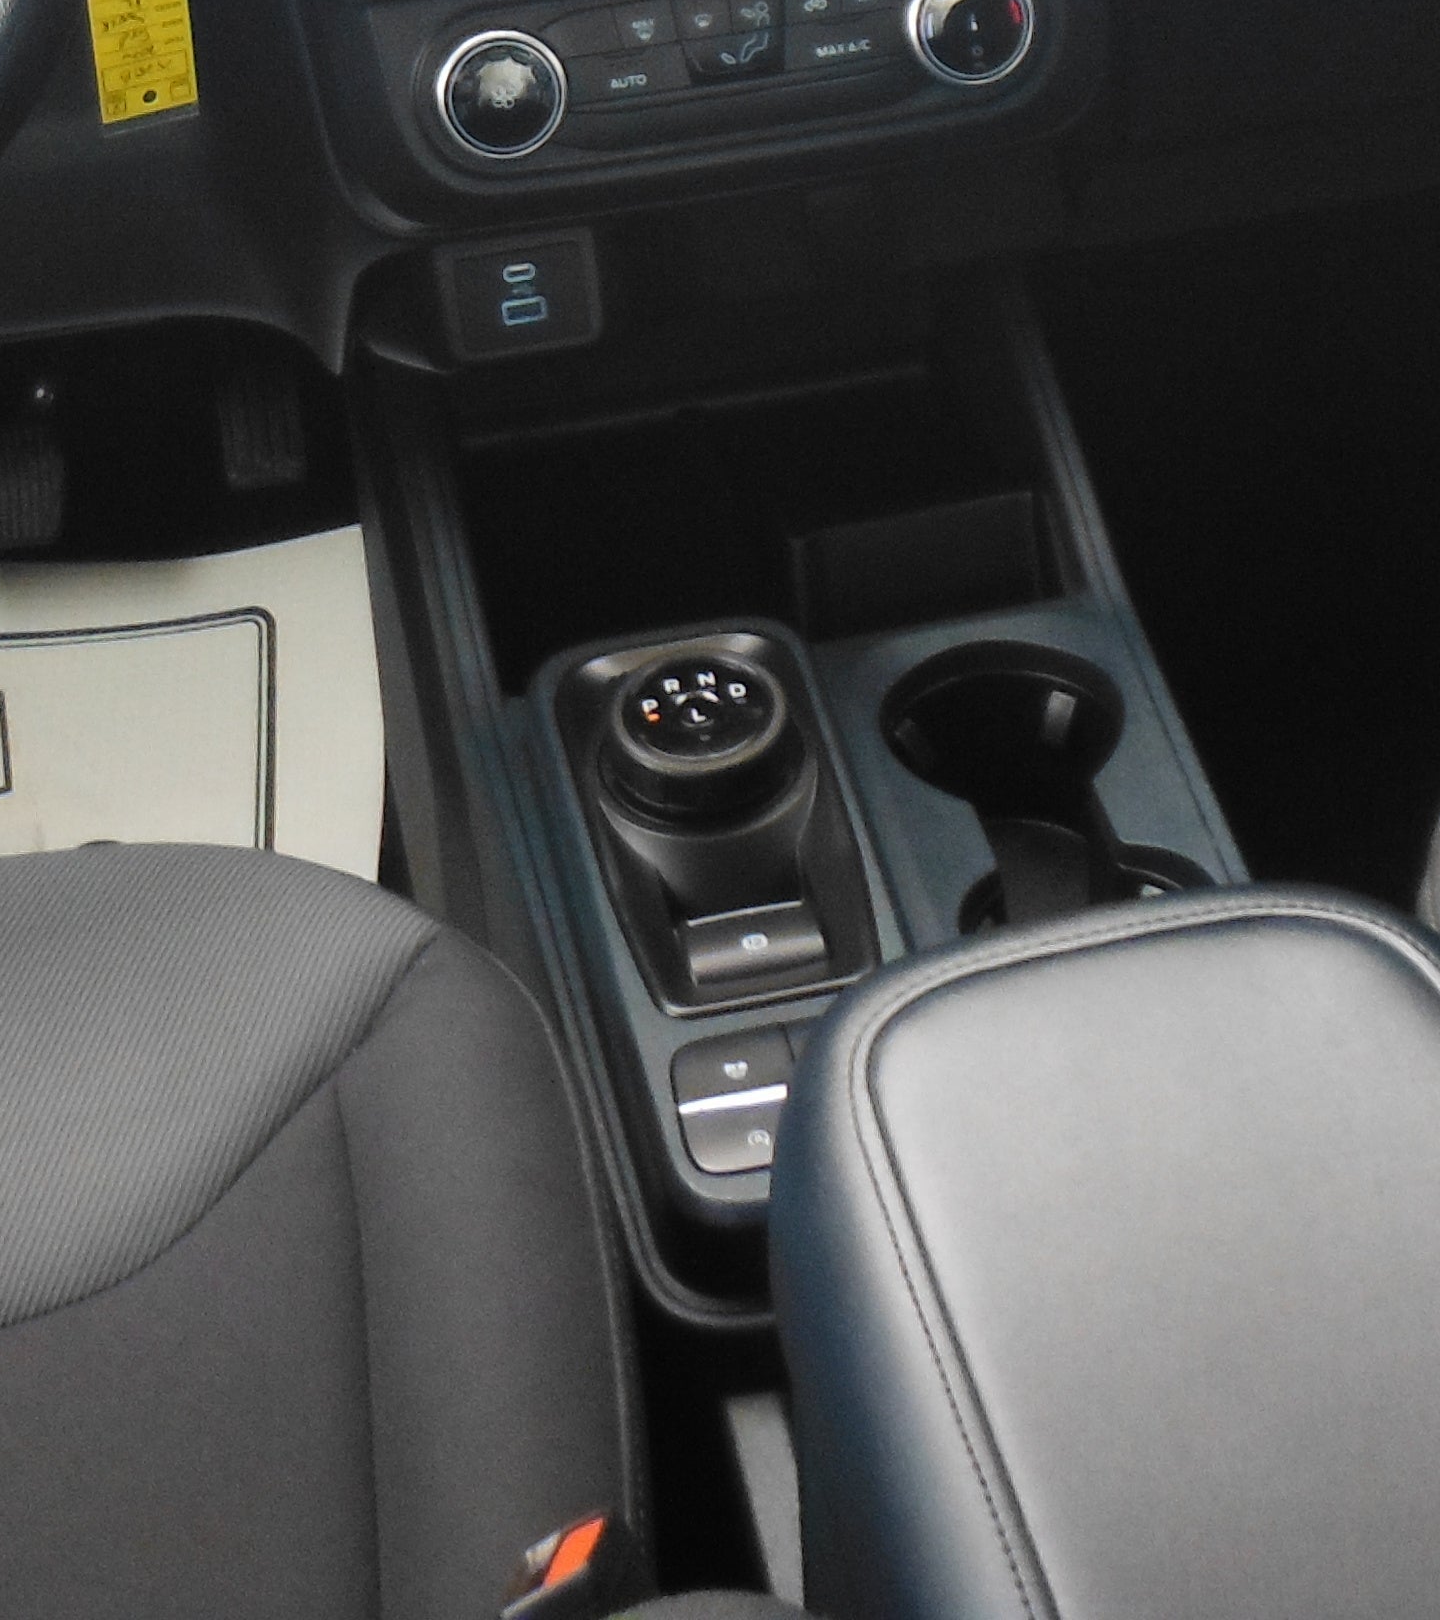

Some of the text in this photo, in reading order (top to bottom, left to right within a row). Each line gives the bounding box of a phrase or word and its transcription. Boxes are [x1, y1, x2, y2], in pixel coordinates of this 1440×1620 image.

[610, 73, 647, 89] AUTO
[662, 678, 680, 695] R
[697, 671, 717, 688] N
[727, 682, 747, 699] D
[641, 698, 659, 715] P
[691, 707, 707, 724] L
